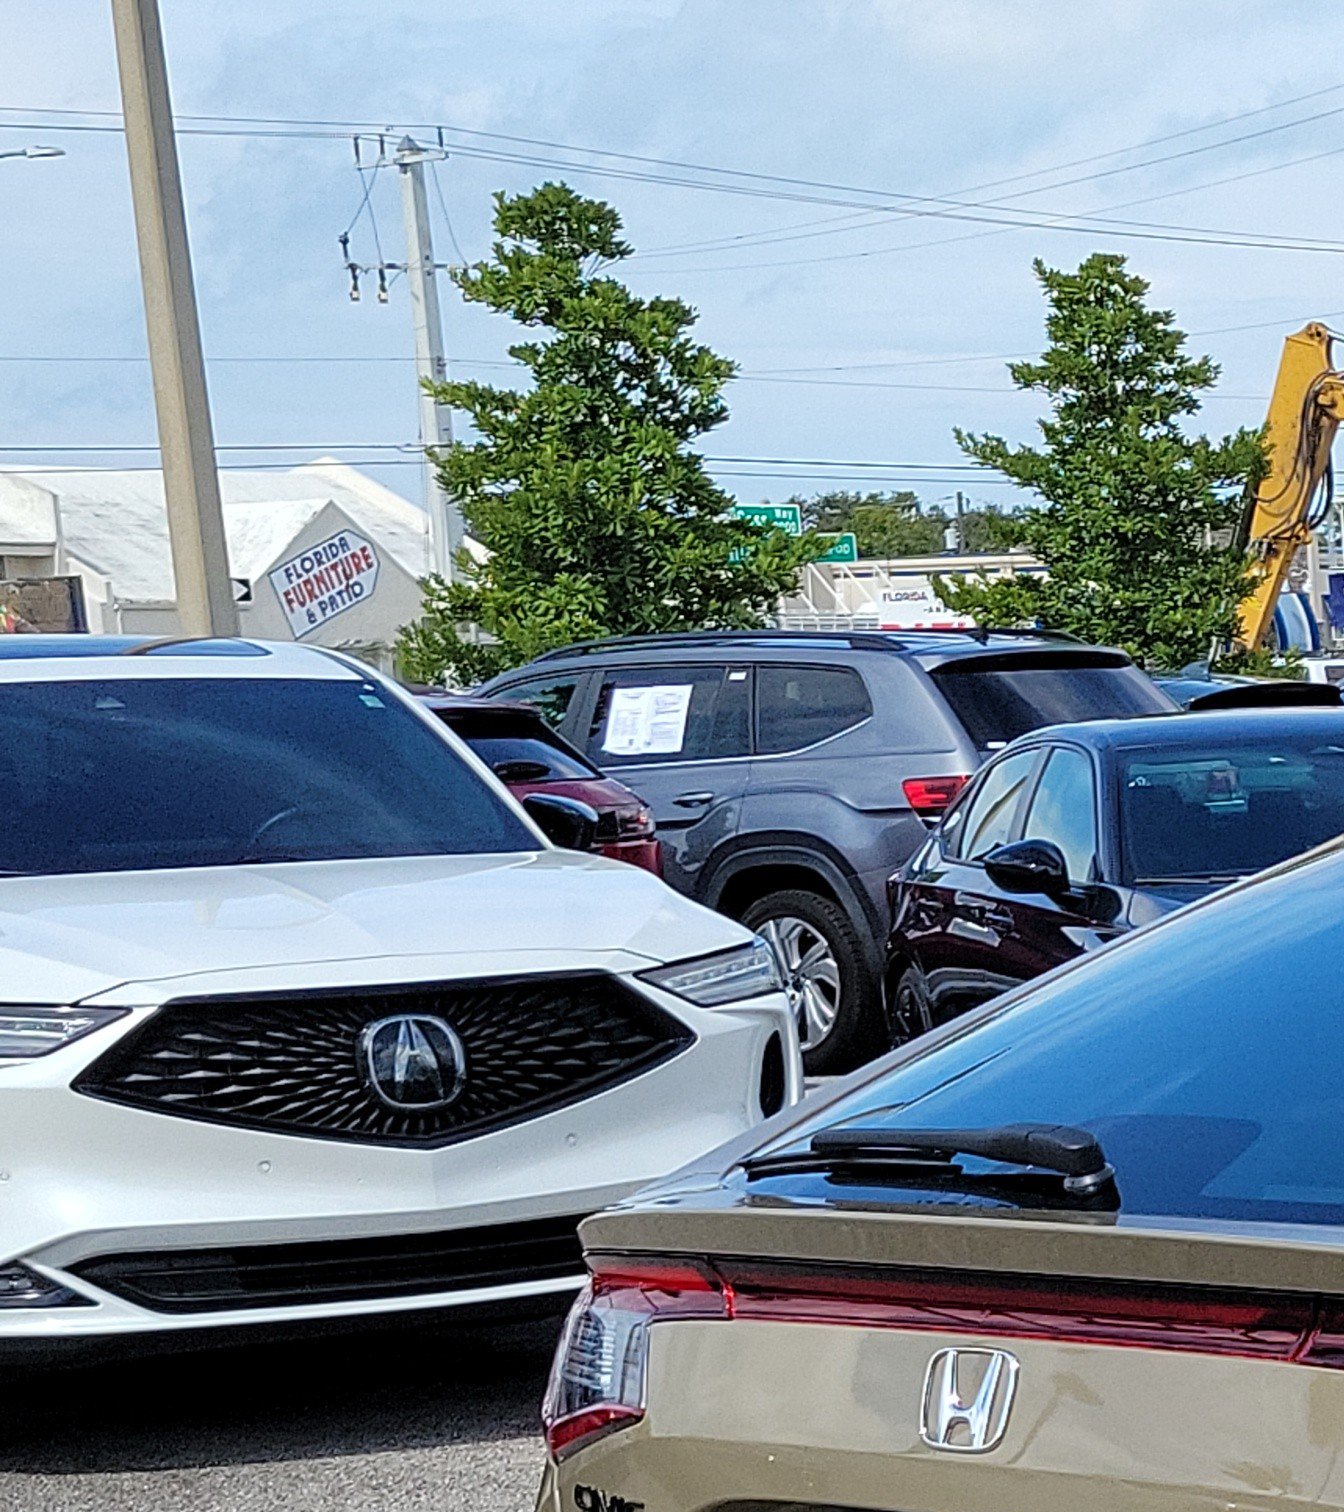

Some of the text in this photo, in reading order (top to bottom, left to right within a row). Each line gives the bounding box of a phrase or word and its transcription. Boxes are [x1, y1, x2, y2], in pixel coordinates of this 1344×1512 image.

[283, 546, 374, 613] FURNITURE
[284, 537, 350, 584] FLORIDA
[306, 581, 364, 624] & PATIO
